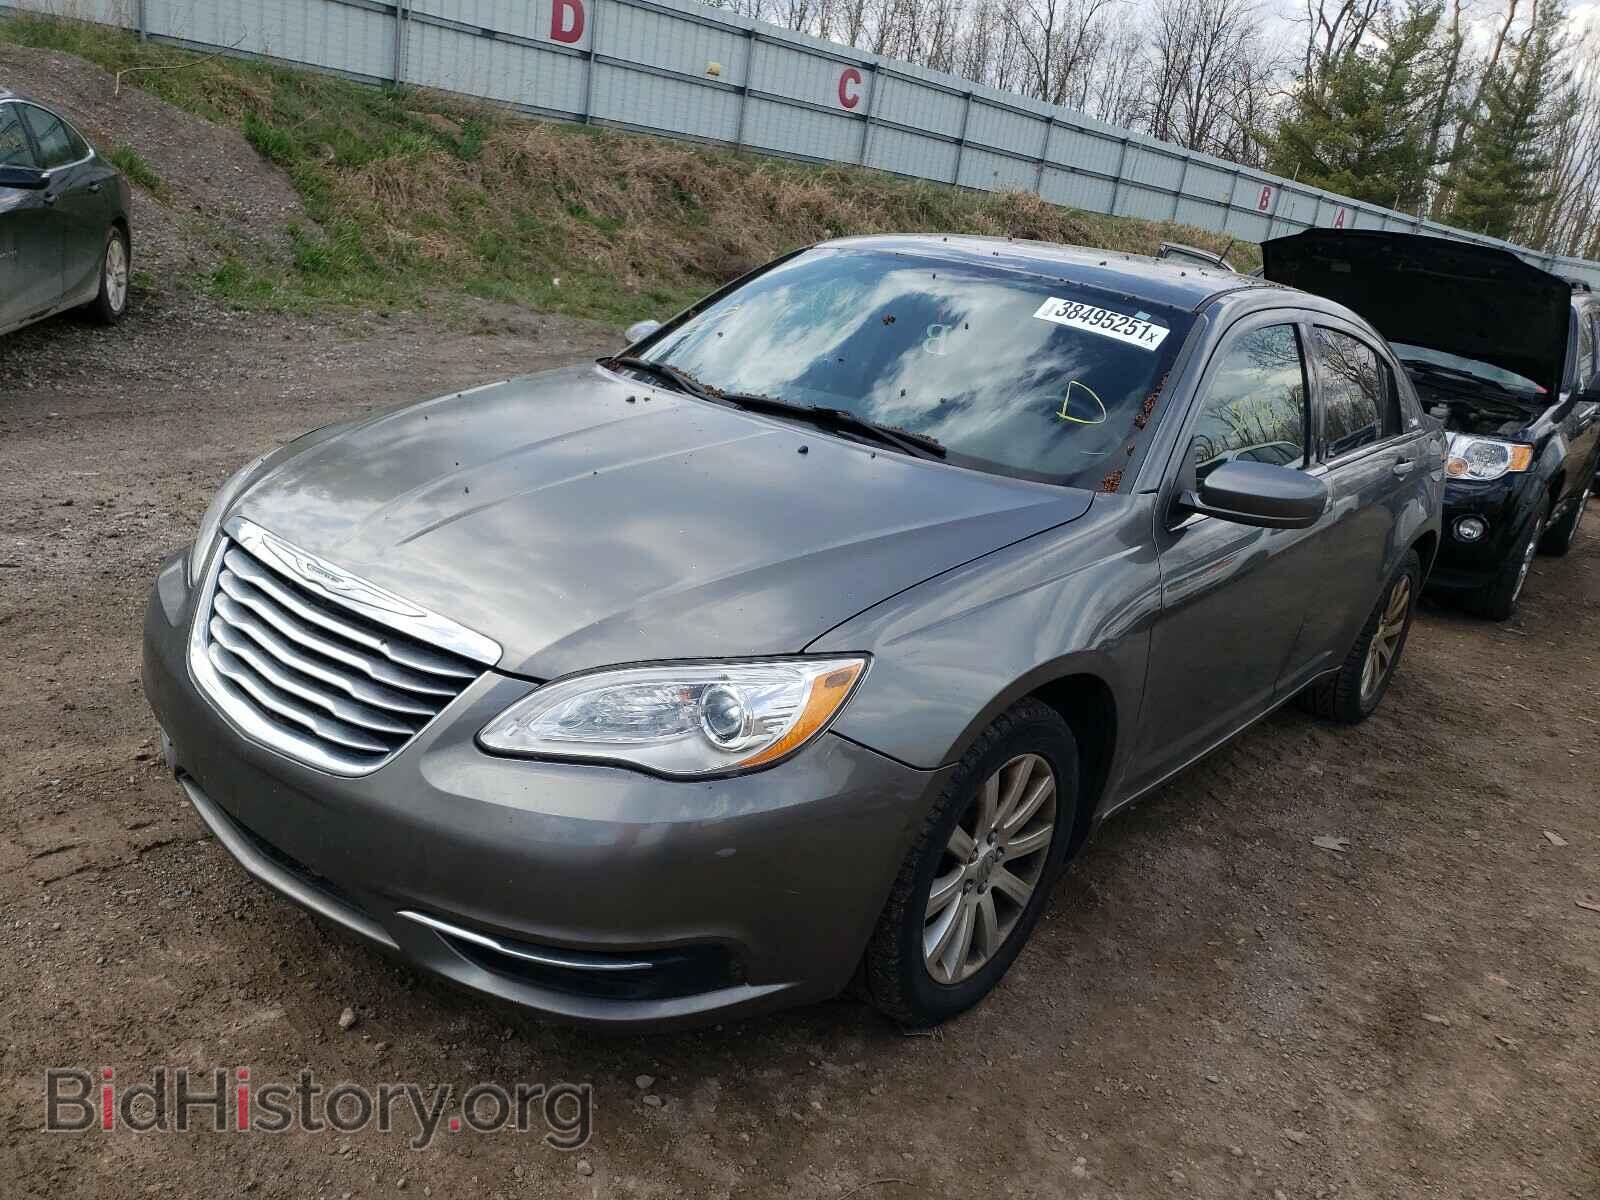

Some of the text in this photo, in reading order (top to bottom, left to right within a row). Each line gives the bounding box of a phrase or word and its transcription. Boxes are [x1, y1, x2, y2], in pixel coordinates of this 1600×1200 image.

[550, 0, 585, 43] D
[838, 68, 862, 109] C
[1258, 186, 1272, 211] B
[1334, 206, 1345, 229] A
[1056, 380, 1107, 424] D
